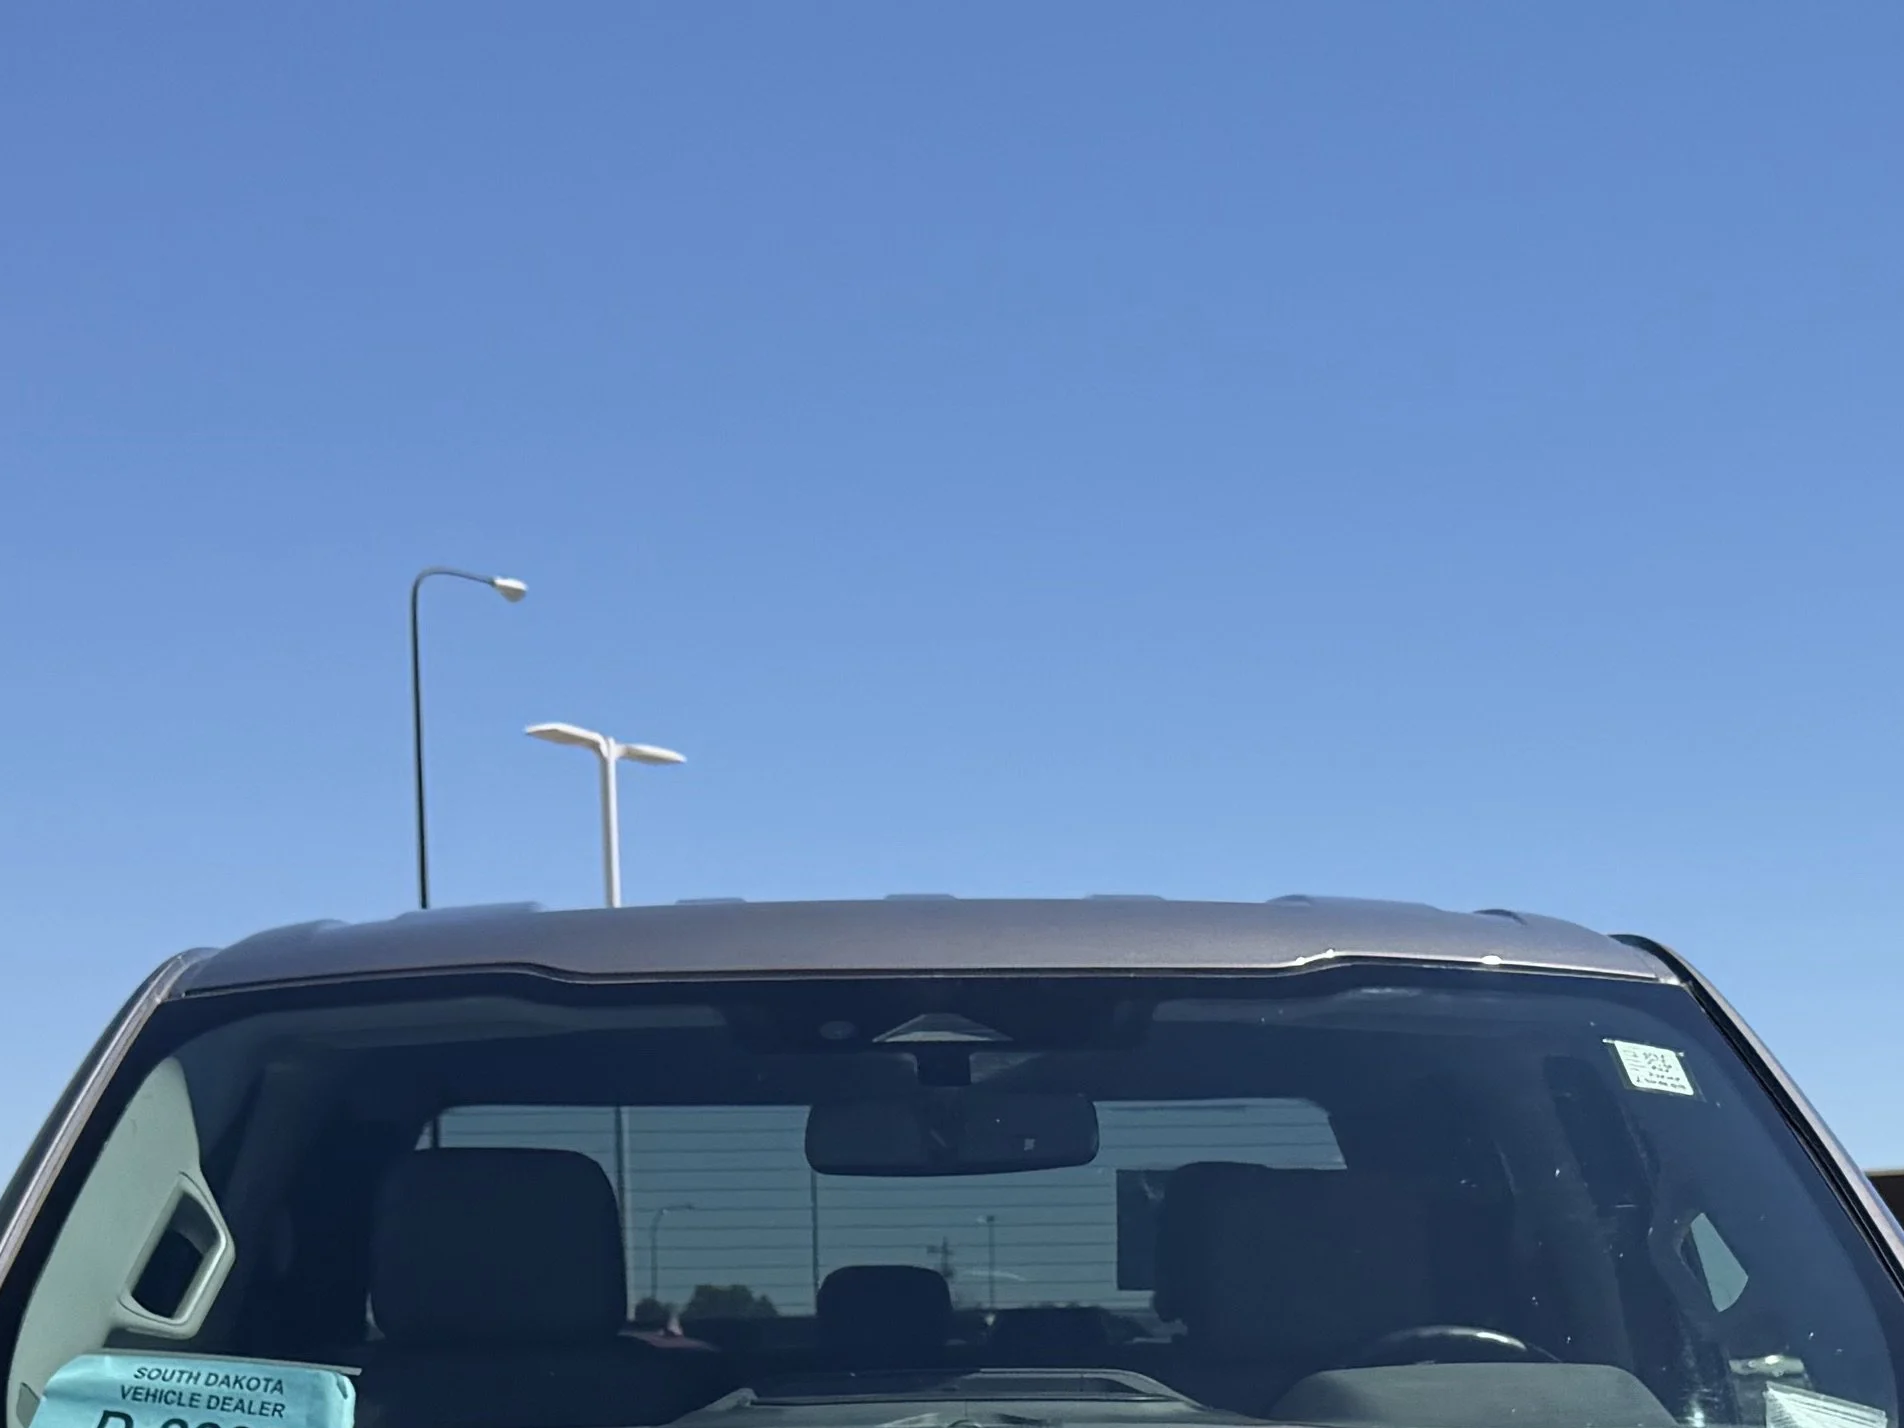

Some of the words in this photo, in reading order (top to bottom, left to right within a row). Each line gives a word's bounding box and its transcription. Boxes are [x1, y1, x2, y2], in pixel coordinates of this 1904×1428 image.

[133, 1366, 199, 1384] SOUTH
[204, 1371, 285, 1395] DAKOTA
[120, 1384, 201, 1408] VEHICLE
[206, 1395, 286, 1419] DEALER
